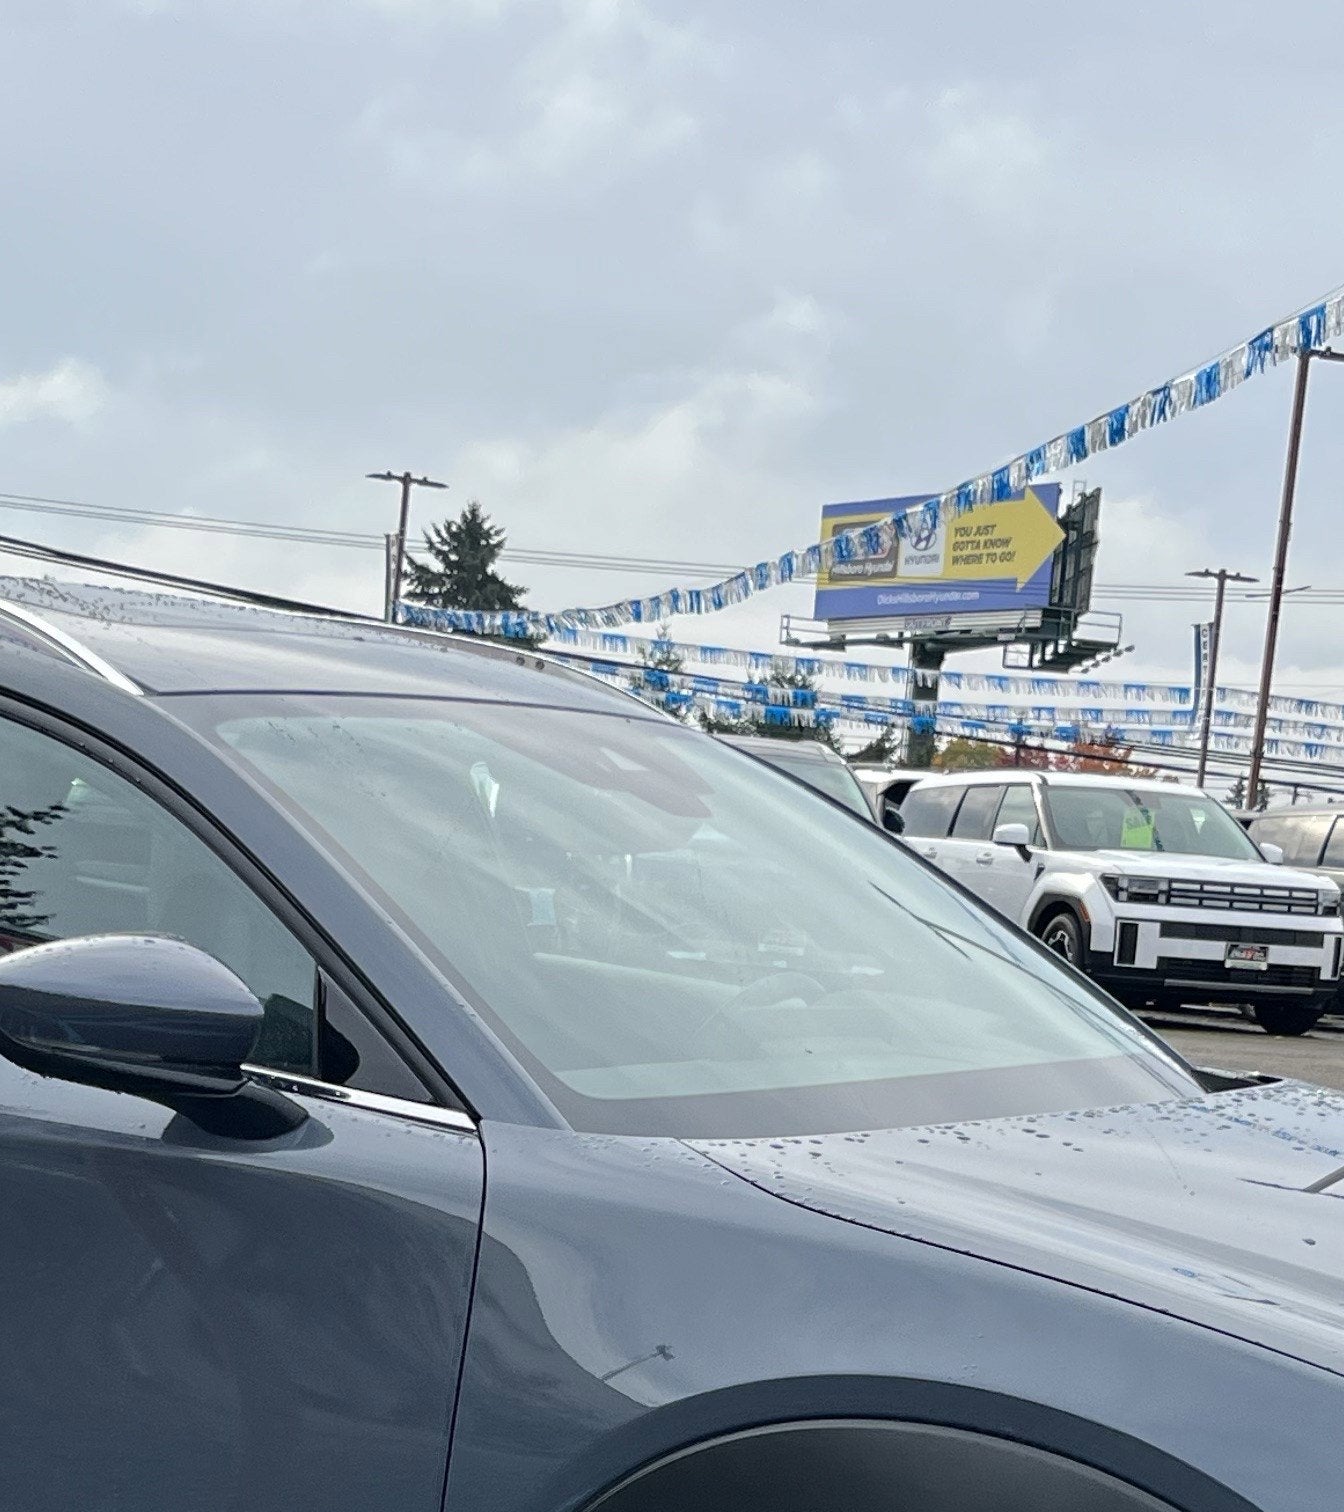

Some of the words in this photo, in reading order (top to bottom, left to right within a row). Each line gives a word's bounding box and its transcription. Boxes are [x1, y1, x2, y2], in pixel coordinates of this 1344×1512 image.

[954, 526, 973, 537] YOU
[973, 524, 997, 536] JUST
[952, 539, 981, 552] GOTTA
[983, 537, 1013, 549] KNOW
[952, 553, 983, 565] WHERE
[985, 552, 997, 564] TO
